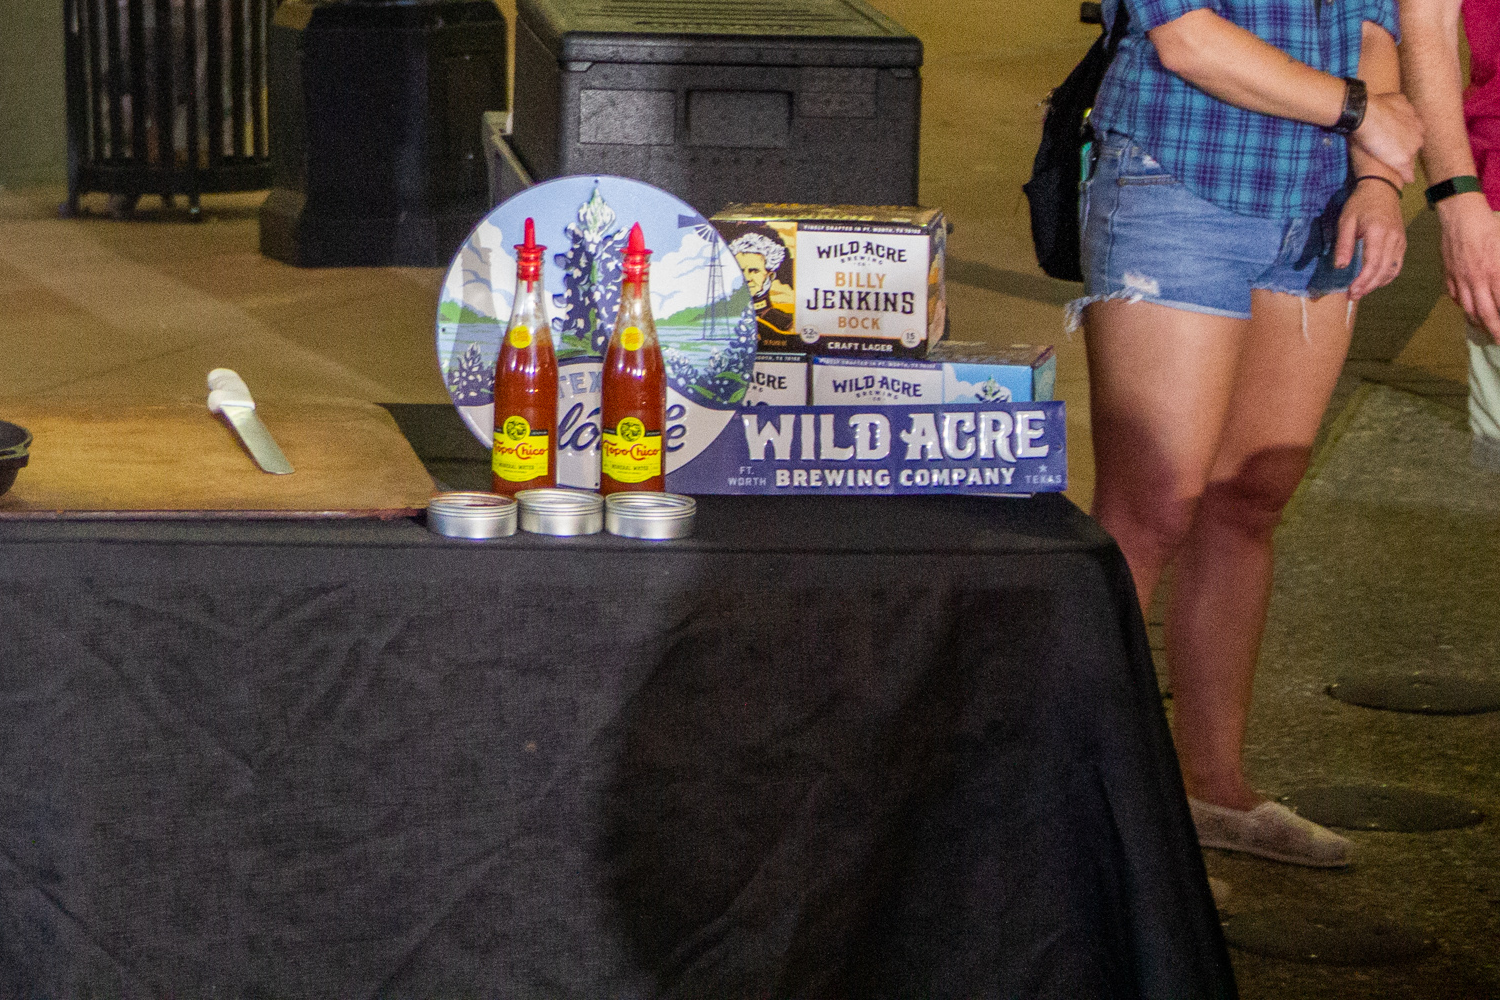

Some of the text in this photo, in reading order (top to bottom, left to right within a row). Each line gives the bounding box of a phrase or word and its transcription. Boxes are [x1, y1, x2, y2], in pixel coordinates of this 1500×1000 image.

[817, 240, 908, 263] WILD ACRE
[840, 255, 884, 265] BREWING
[835, 271, 886, 289] BILLY
[806, 288, 915, 315] JENKINS
[837, 316, 881, 331] BOCK
[827, 341, 894, 353] CRAFT LAGER
[832, 375, 923, 398] WILD ACRE
[742, 410, 1050, 462] WILD ACRE
[514, 442, 548, 460] Chico
[603, 439, 659, 461] Topo Chico
[739, 466, 755, 476] FT.
[775, 467, 1016, 488] BREWING COMPANY
[1025, 474, 1063, 485] TEXAS
[727, 476, 767, 488] WORTH
